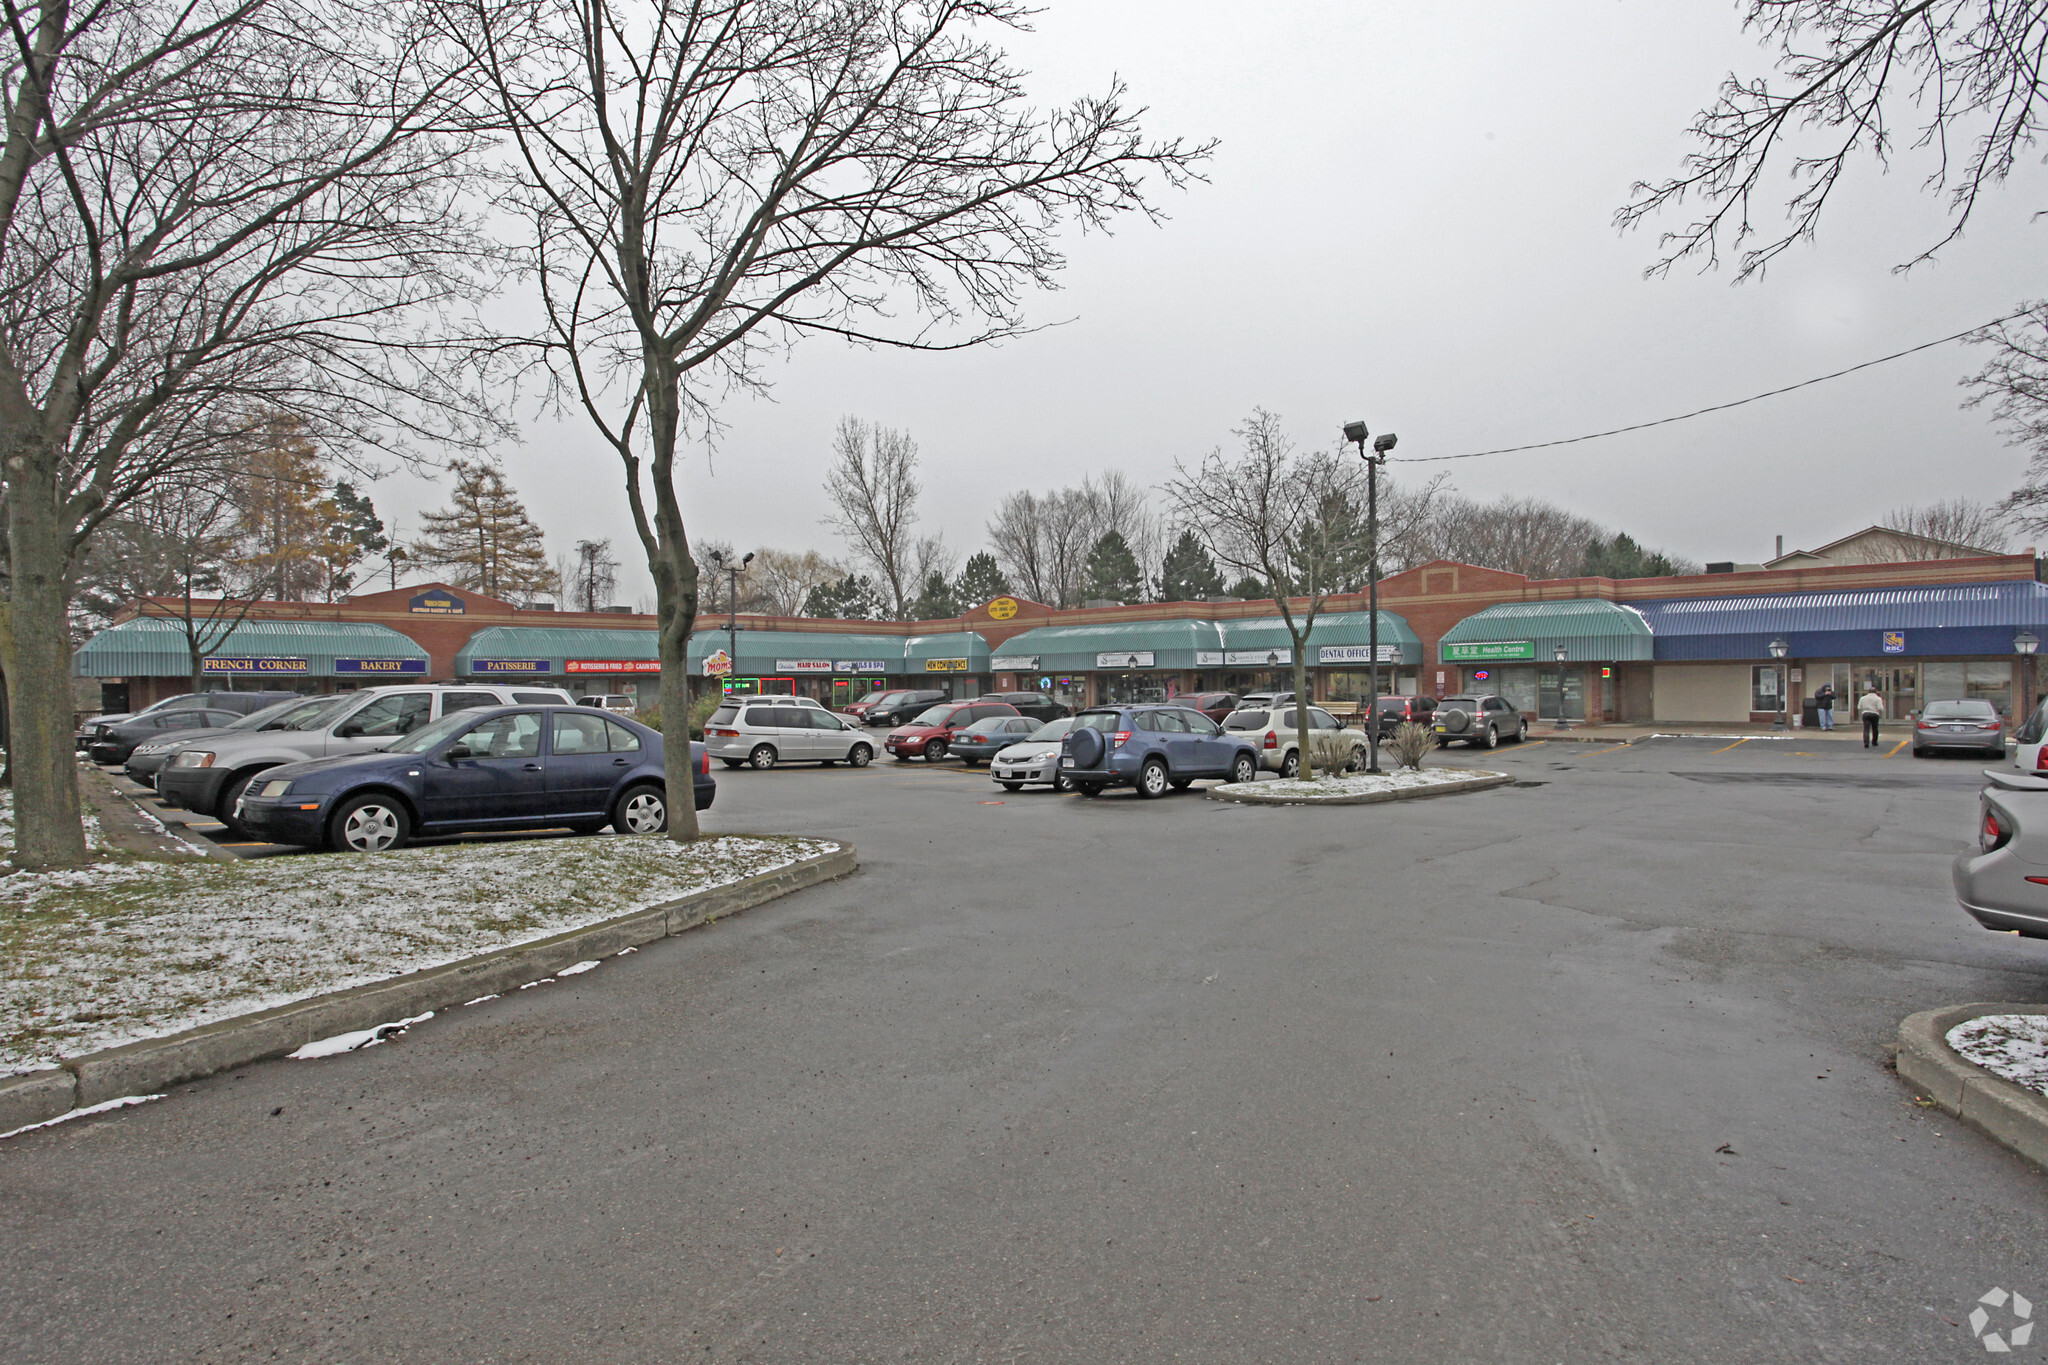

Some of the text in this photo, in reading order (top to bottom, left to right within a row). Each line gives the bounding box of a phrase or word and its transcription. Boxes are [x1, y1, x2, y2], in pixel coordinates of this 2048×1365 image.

[1320, 649, 1344, 659] DENTAL
[1346, 648, 1370, 658] OFFICE
[1482, 646, 1502, 654] Health
[204, 660, 307, 670] FRENCH CORNER
[360, 661, 402, 670] BAKERY
[487, 662, 537, 671] PATISSERIE
[873, 661, 884, 669] SPA
